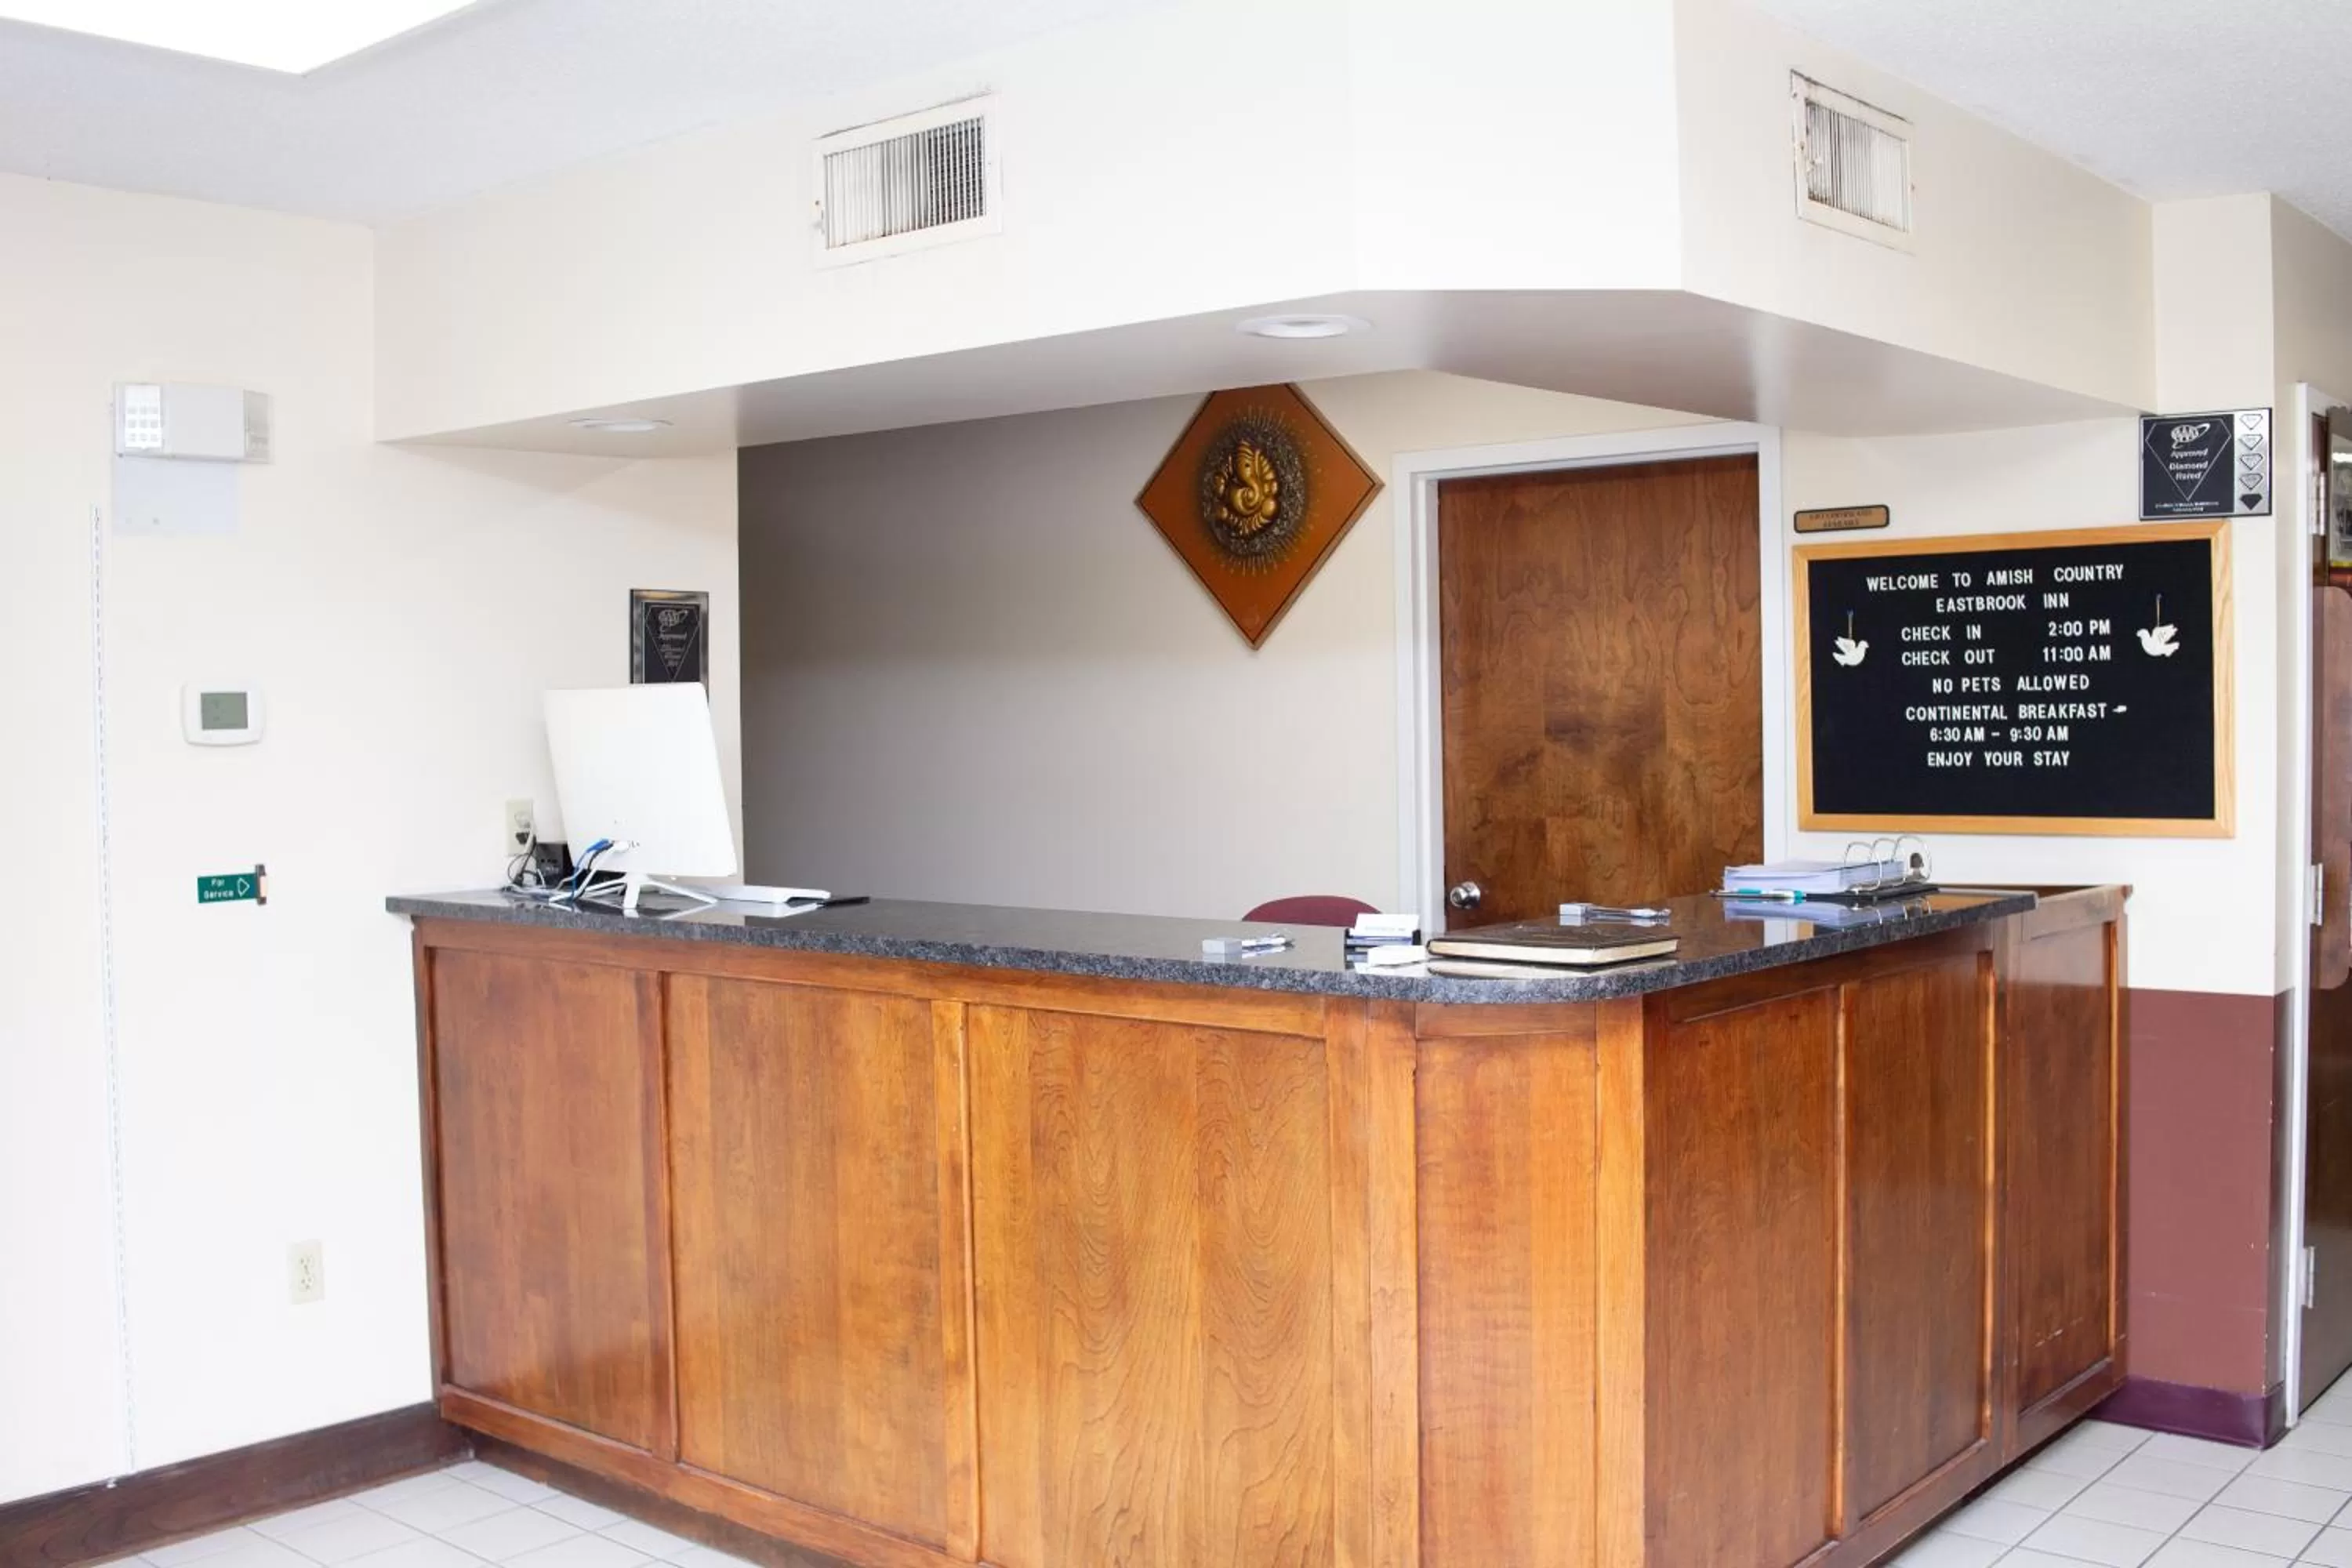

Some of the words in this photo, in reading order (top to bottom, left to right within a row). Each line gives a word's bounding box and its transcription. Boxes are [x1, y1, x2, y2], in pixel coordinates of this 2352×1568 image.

[2170, 448, 2209, 459] Approved
[2169, 461, 2209, 471] Diamond
[1866, 573, 1939, 592] WELCOME
[1951, 572, 1972, 588] TO
[1986, 568, 2033, 586] AMISH
[2053, 564, 2124, 583] COUNTRY
[1936, 593, 2027, 613] EASTBROOK
[2043, 592, 2069, 609] INN
[1900, 625, 1951, 642] CHECK
[1966, 624, 1981, 641] IN
[2048, 620, 2083, 637] 2:00
[2089, 618, 2111, 636] PM
[1901, 650, 1951, 666] CHECK
[1964, 648, 1995, 665] OUT
[2042, 645, 2084, 662] 11:00
[2088, 644, 2111, 661] AM
[1932, 677, 1953, 695] NO
[1961, 677, 2002, 693] PETS
[2016, 673, 2090, 691] ALLOWED
[1905, 704, 2008, 722] CONTINENTAL
[2018, 702, 2107, 720] BREAKFAST
[1929, 727, 1961, 742] 6:30
[1963, 726, 1985, 742] AM
[2009, 725, 2042, 742] 9:30
[2046, 725, 2069, 742] AM
[1927, 751, 1973, 768] ENJOY
[1984, 750, 2024, 767] YOUR
[2033, 750, 2071, 767] STAY
[204, 891, 234, 900] Service
